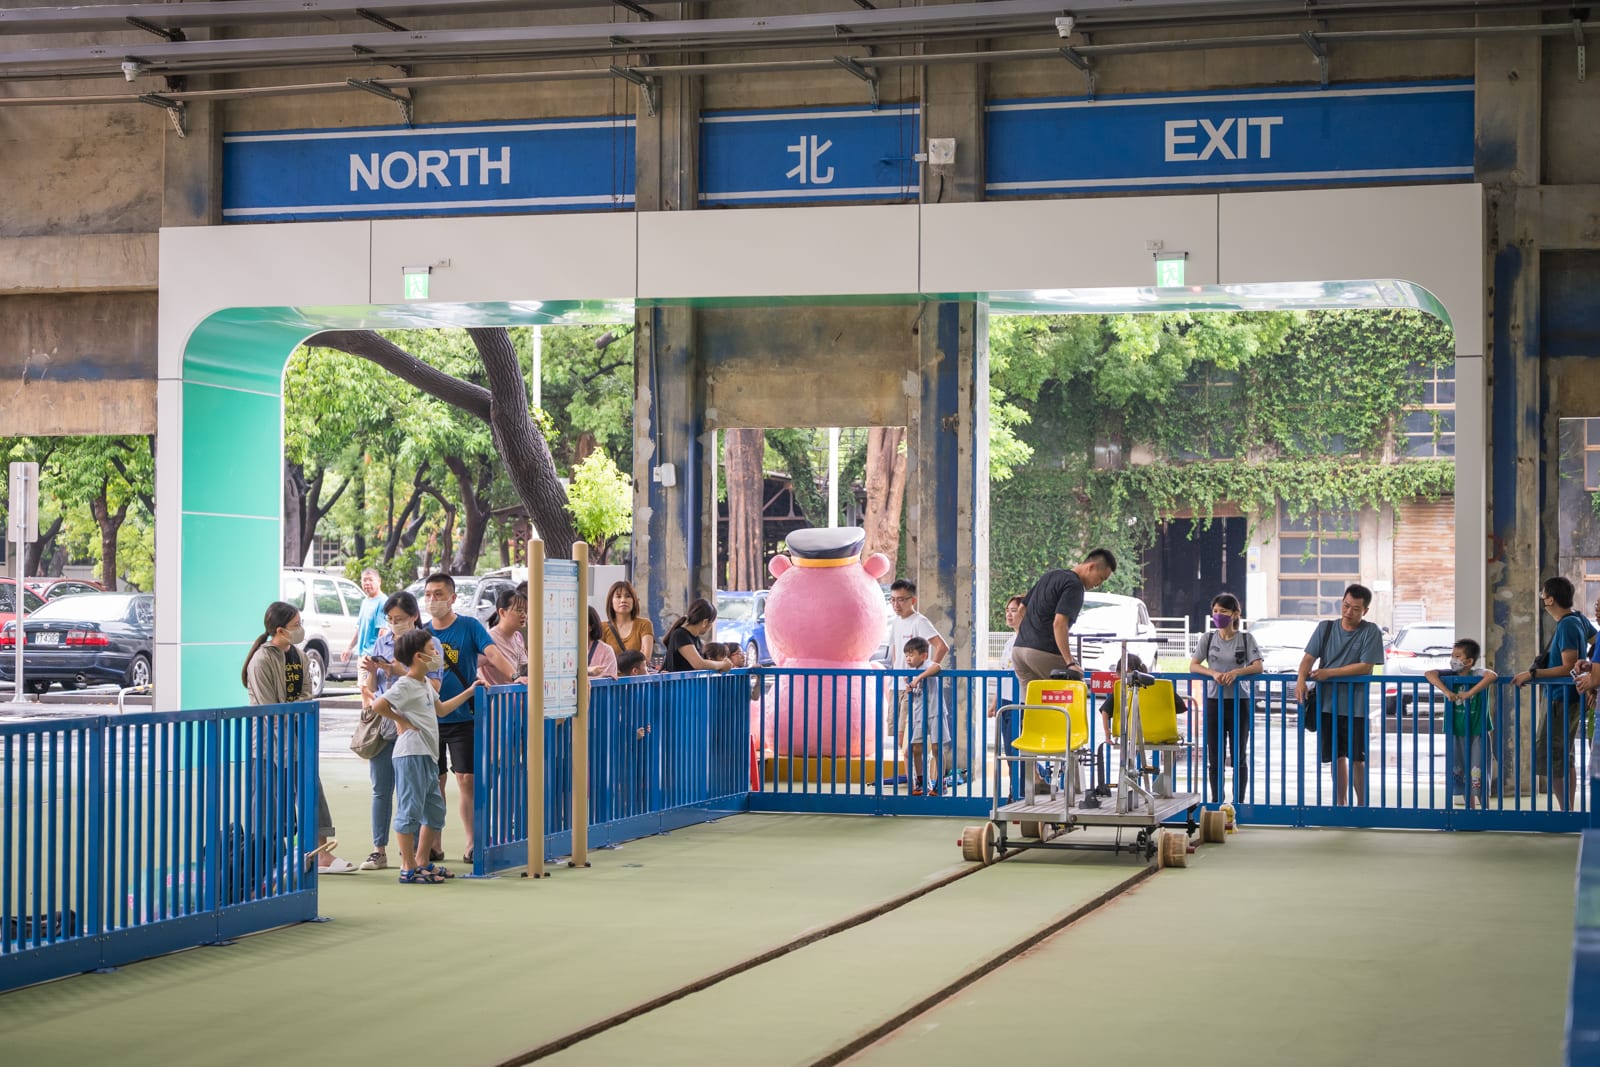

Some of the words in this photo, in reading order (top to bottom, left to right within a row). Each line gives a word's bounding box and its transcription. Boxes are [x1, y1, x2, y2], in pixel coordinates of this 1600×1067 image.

[785, 134, 835, 184] 北
[1165, 116, 1284, 162] EXIT
[350, 146, 511, 192] NORTH
